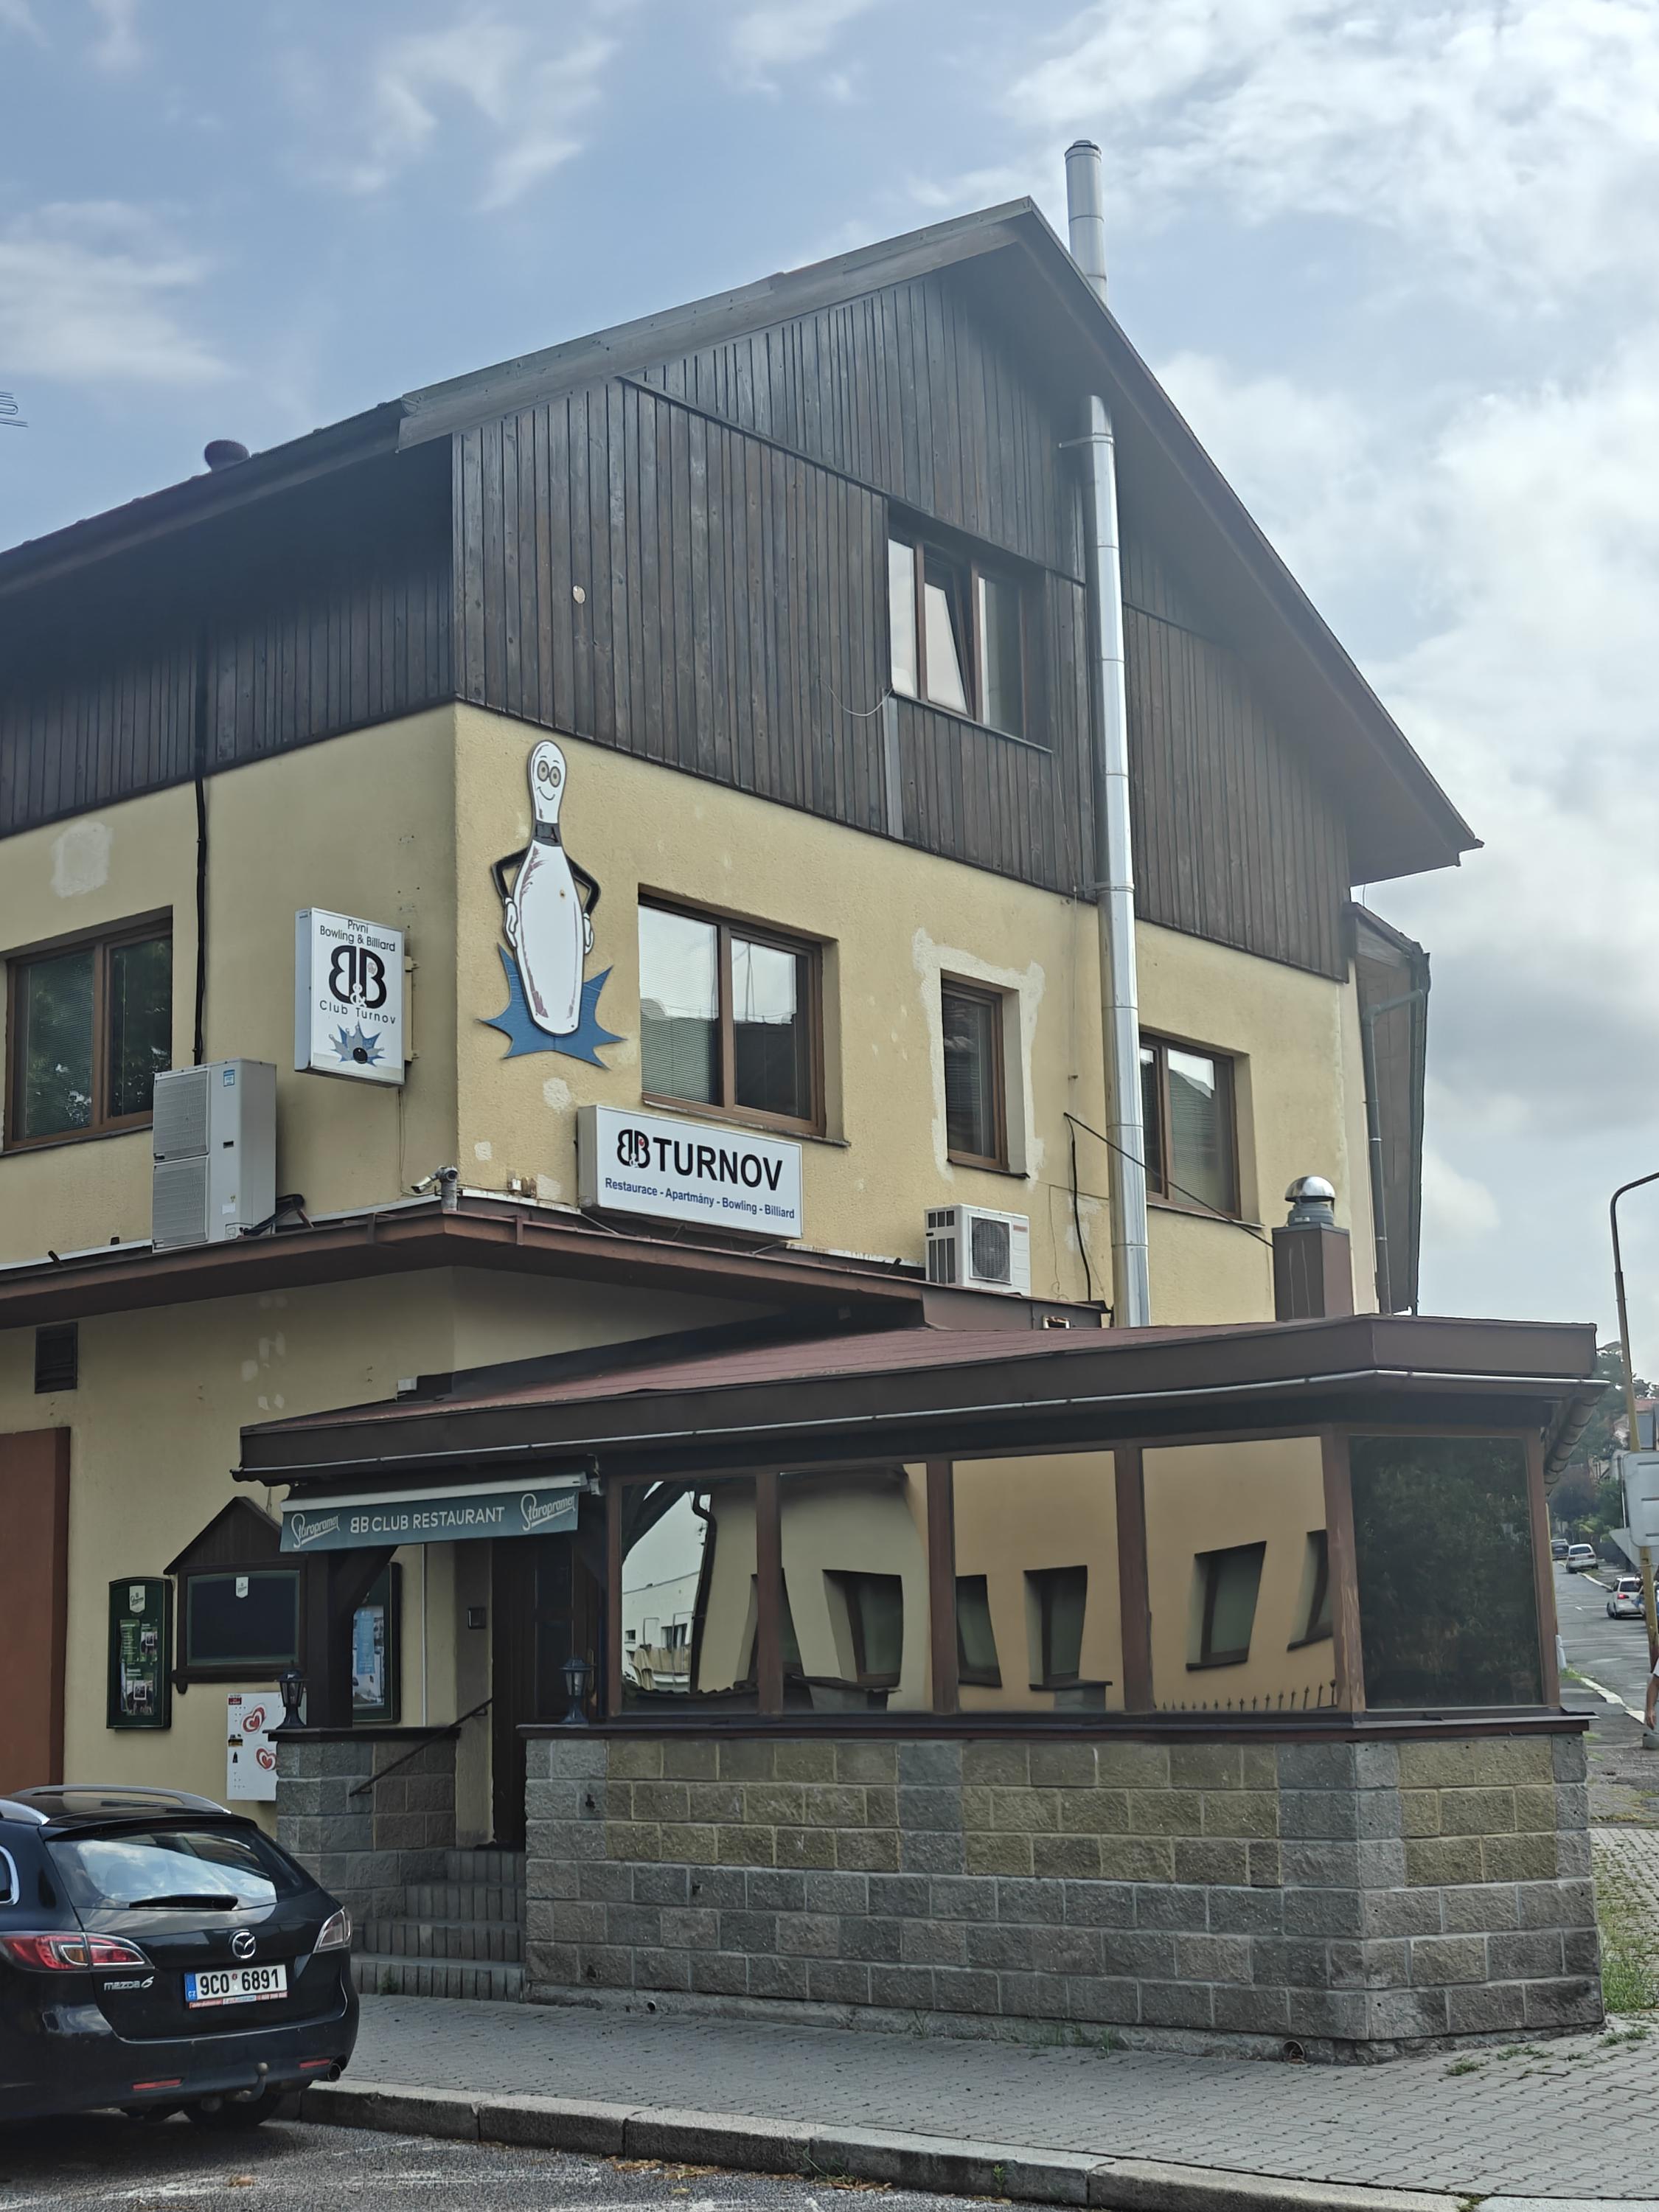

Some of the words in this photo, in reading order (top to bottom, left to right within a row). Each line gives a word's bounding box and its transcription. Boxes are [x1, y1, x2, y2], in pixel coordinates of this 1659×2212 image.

[320, 925, 355, 945] Bowling
[357, 934, 365, 945] &
[366, 936, 396, 952] Billiard
[319, 1000, 348, 1015] Club
[355, 1007, 396, 1024] Turnov
[653, 1137, 783, 1191] TURNOV
[605, 1178, 658, 1196] Restaurace
[665, 1188, 714, 1208] Apartmány
[723, 1197, 757, 1215] Bowling
[765, 1204, 795, 1219] Billiard
[372, 1515, 408, 1532] CLUB
[413, 1506, 505, 1529] RESTAURANT
[241, 1968, 279, 1992] 6891
[187, 1990, 197, 1998] CZ
